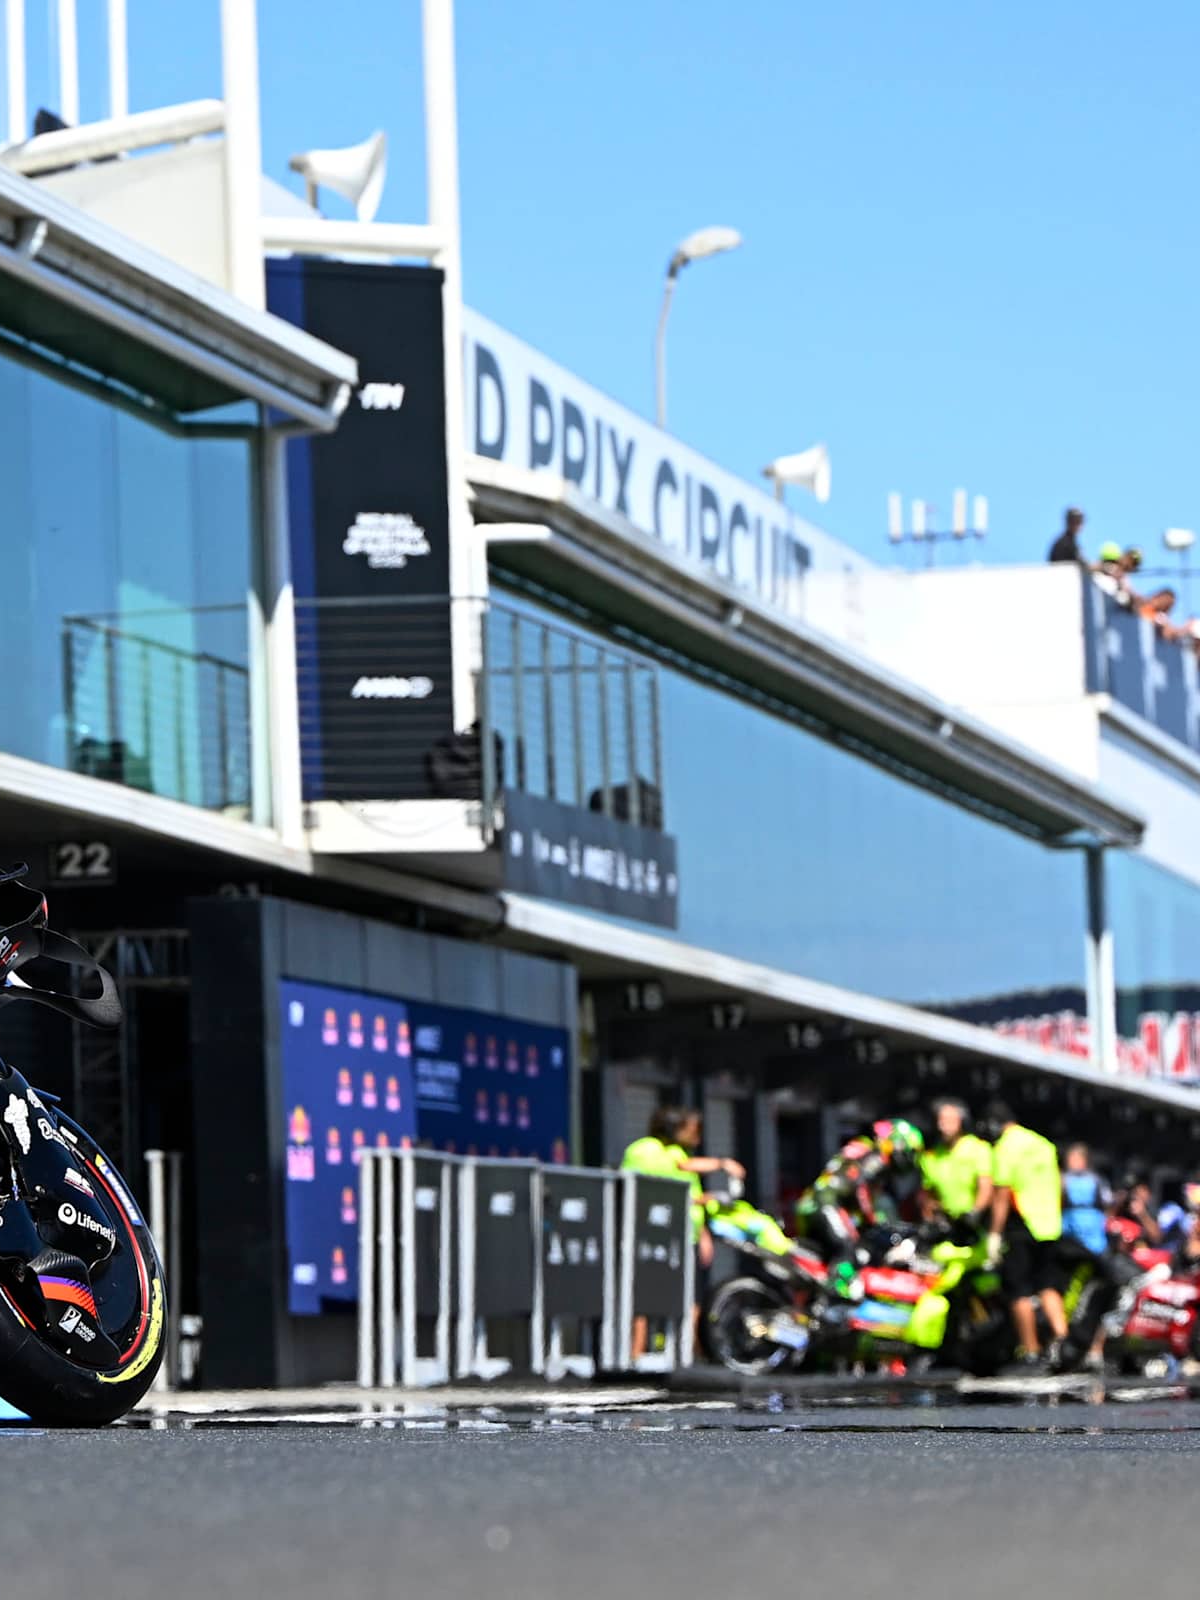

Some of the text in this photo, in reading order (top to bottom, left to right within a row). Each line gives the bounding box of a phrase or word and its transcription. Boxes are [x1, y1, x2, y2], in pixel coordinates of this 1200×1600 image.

[529, 375, 637, 515] PRIX
[58, 842, 111, 877] 22
[712, 1004, 745, 1031] 17
